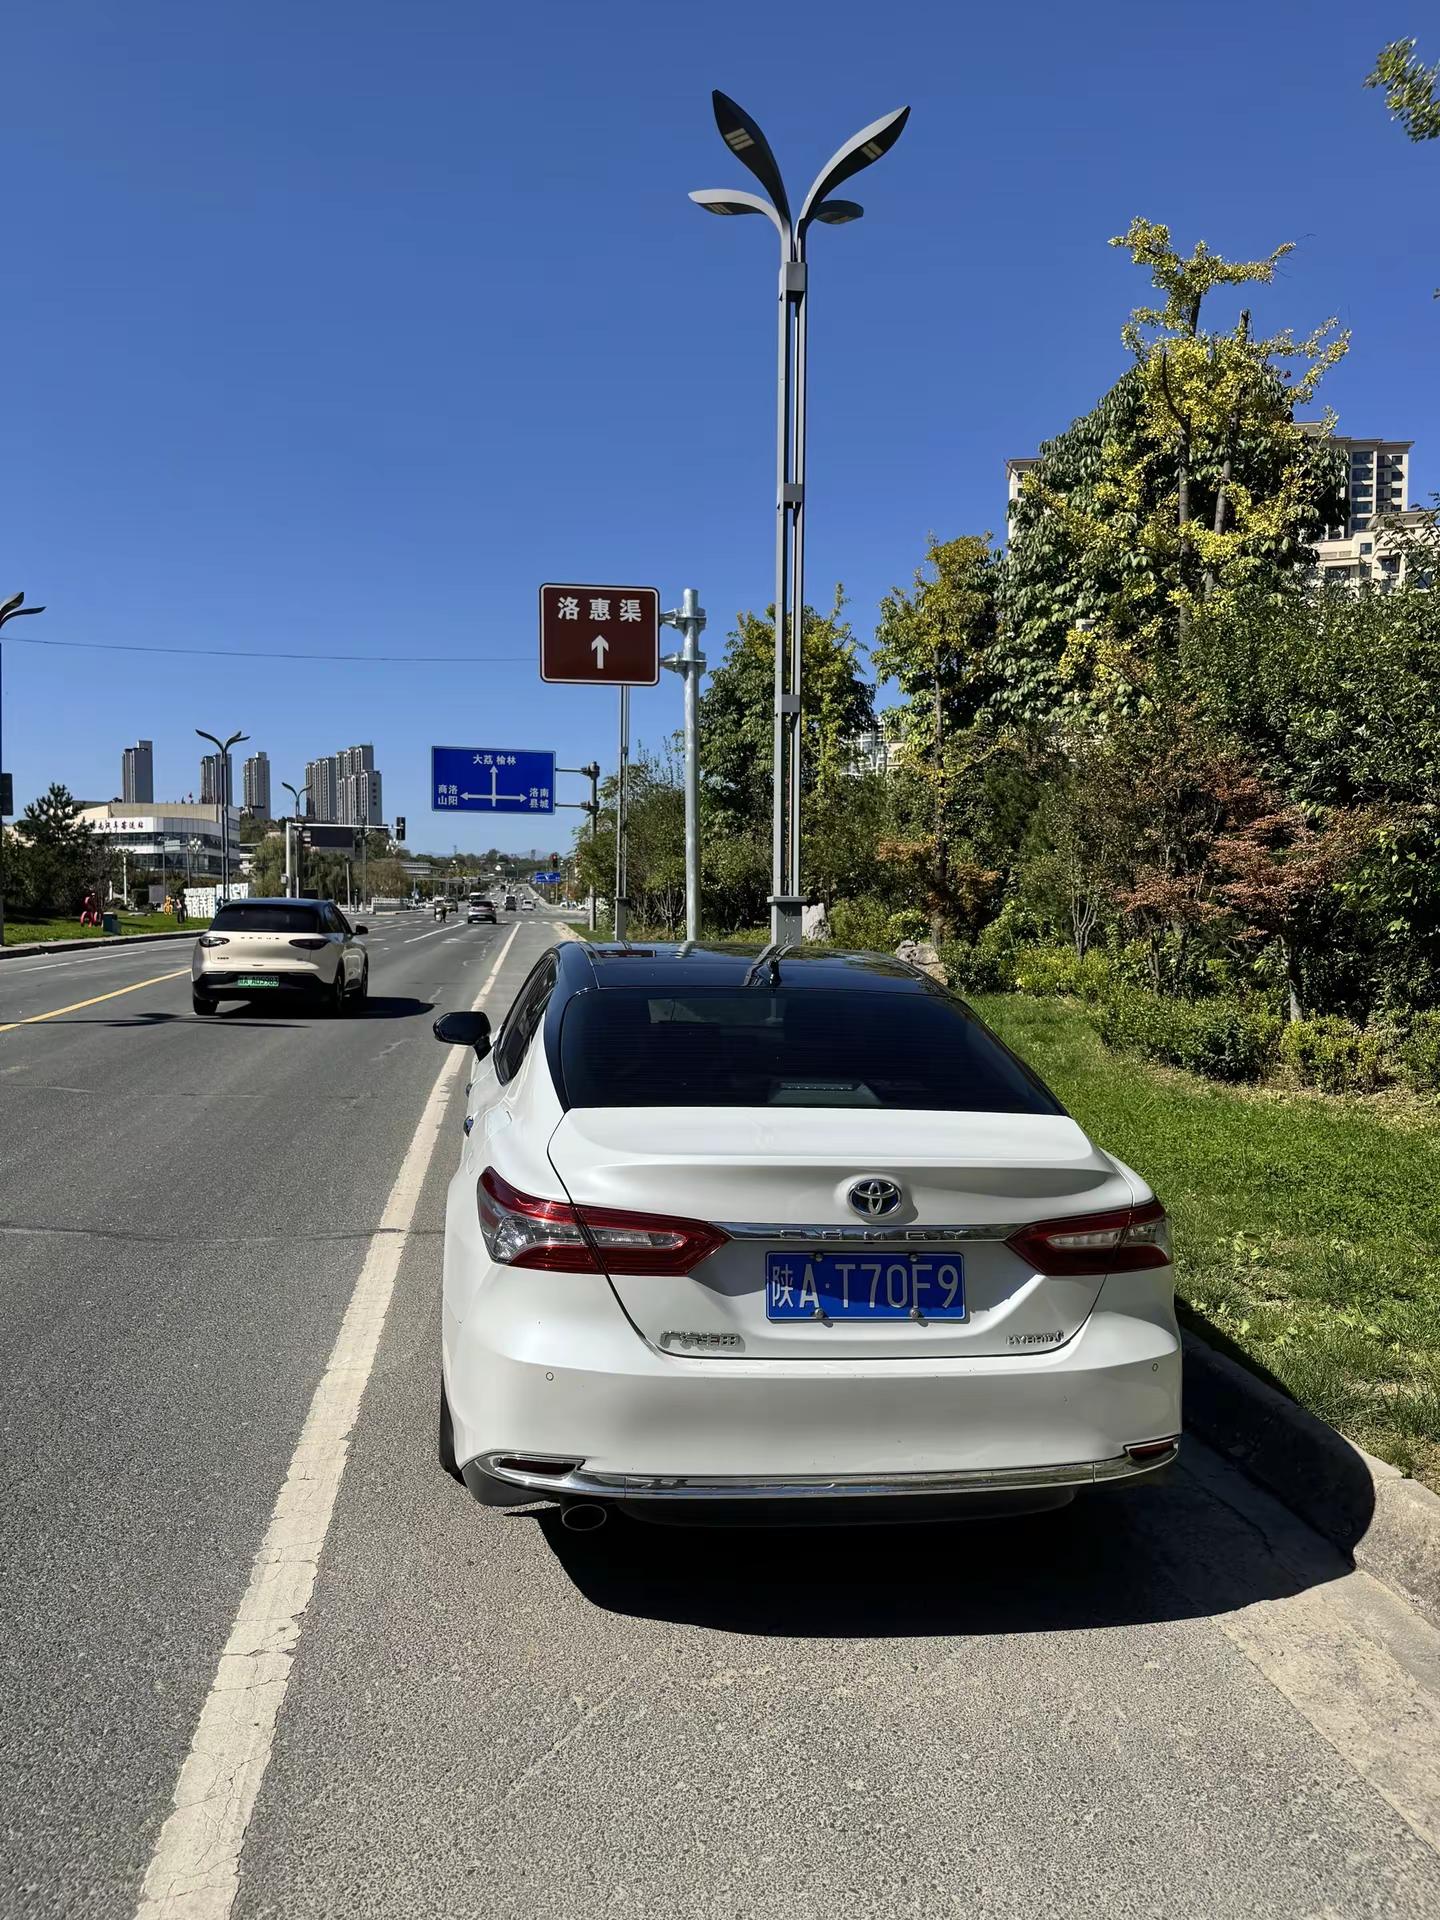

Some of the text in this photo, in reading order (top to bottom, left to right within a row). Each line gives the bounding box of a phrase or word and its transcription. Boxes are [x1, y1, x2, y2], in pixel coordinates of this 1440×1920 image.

[557, 596, 642, 622] 洛惠渠
[438, 784, 458, 794] 商洛
[529, 788, 549, 798] 洛南
[438, 796, 458, 806] 山阳
[529, 798, 549, 809] 县城
[1006, 1333, 1055, 1345] HYBRID
